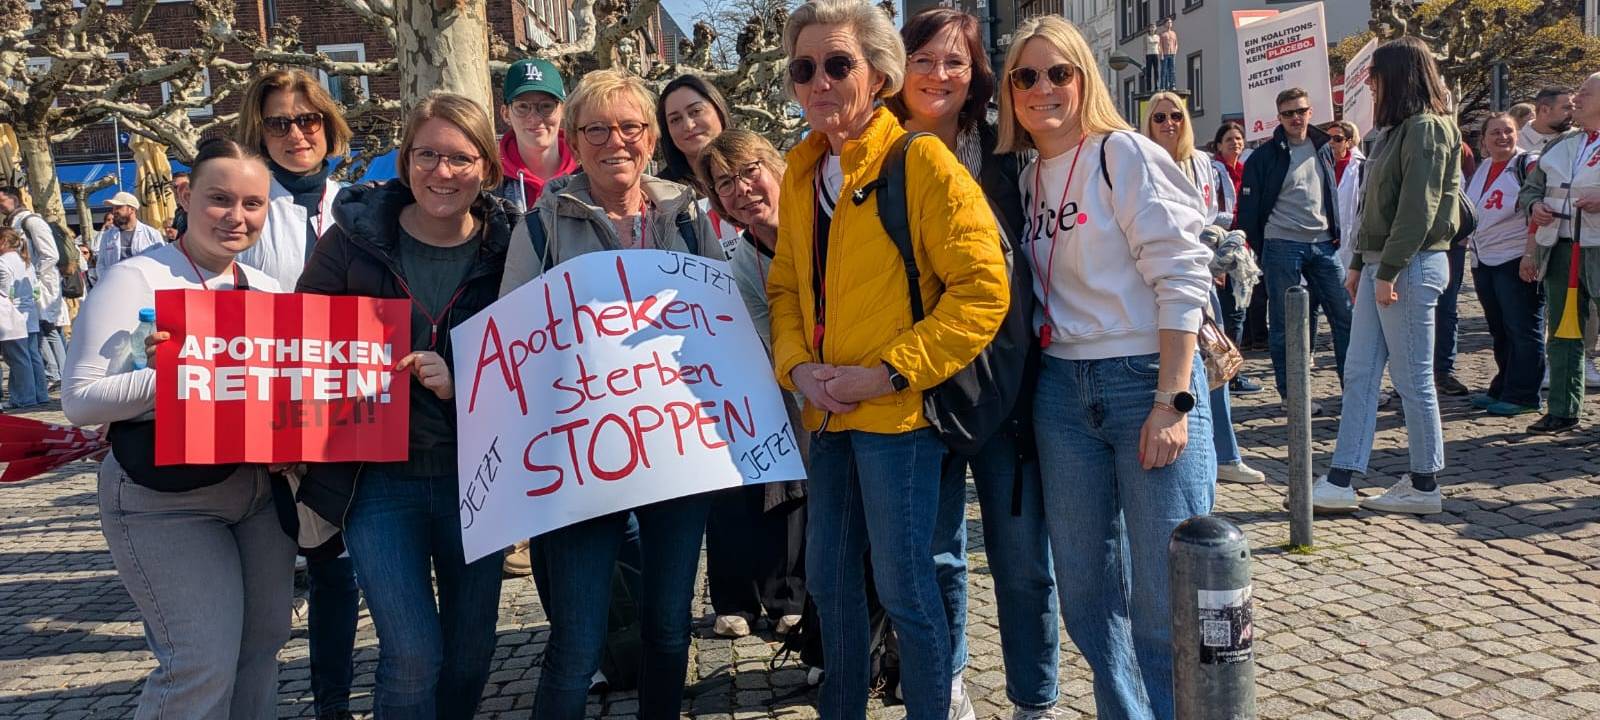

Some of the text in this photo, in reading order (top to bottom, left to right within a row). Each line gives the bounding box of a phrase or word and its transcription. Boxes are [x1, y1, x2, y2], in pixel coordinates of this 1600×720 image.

[1244, 22, 1317, 48] EIN KOALITIONS-
[1245, 34, 1302, 55] VERTRAG IST
[1246, 40, 1313, 64] KEIN PLACEBO.
[525, 62, 543, 80] LA
[1248, 60, 1302, 81] JETZT WORT
[1248, 74, 1284, 89] HALTEN!
[657, 251, 736, 294] JETZT
[177, 334, 392, 366] APOTHEKEN
[468, 255, 734, 416] Apotheken-
[177, 364, 392, 404] RETTEN!
[552, 351, 723, 414] sterben
[269, 395, 376, 431] JETZT!
[523, 396, 756, 497] STOPPEN
[739, 423, 798, 480] JETZT
[459, 436, 505, 530] JETZT
